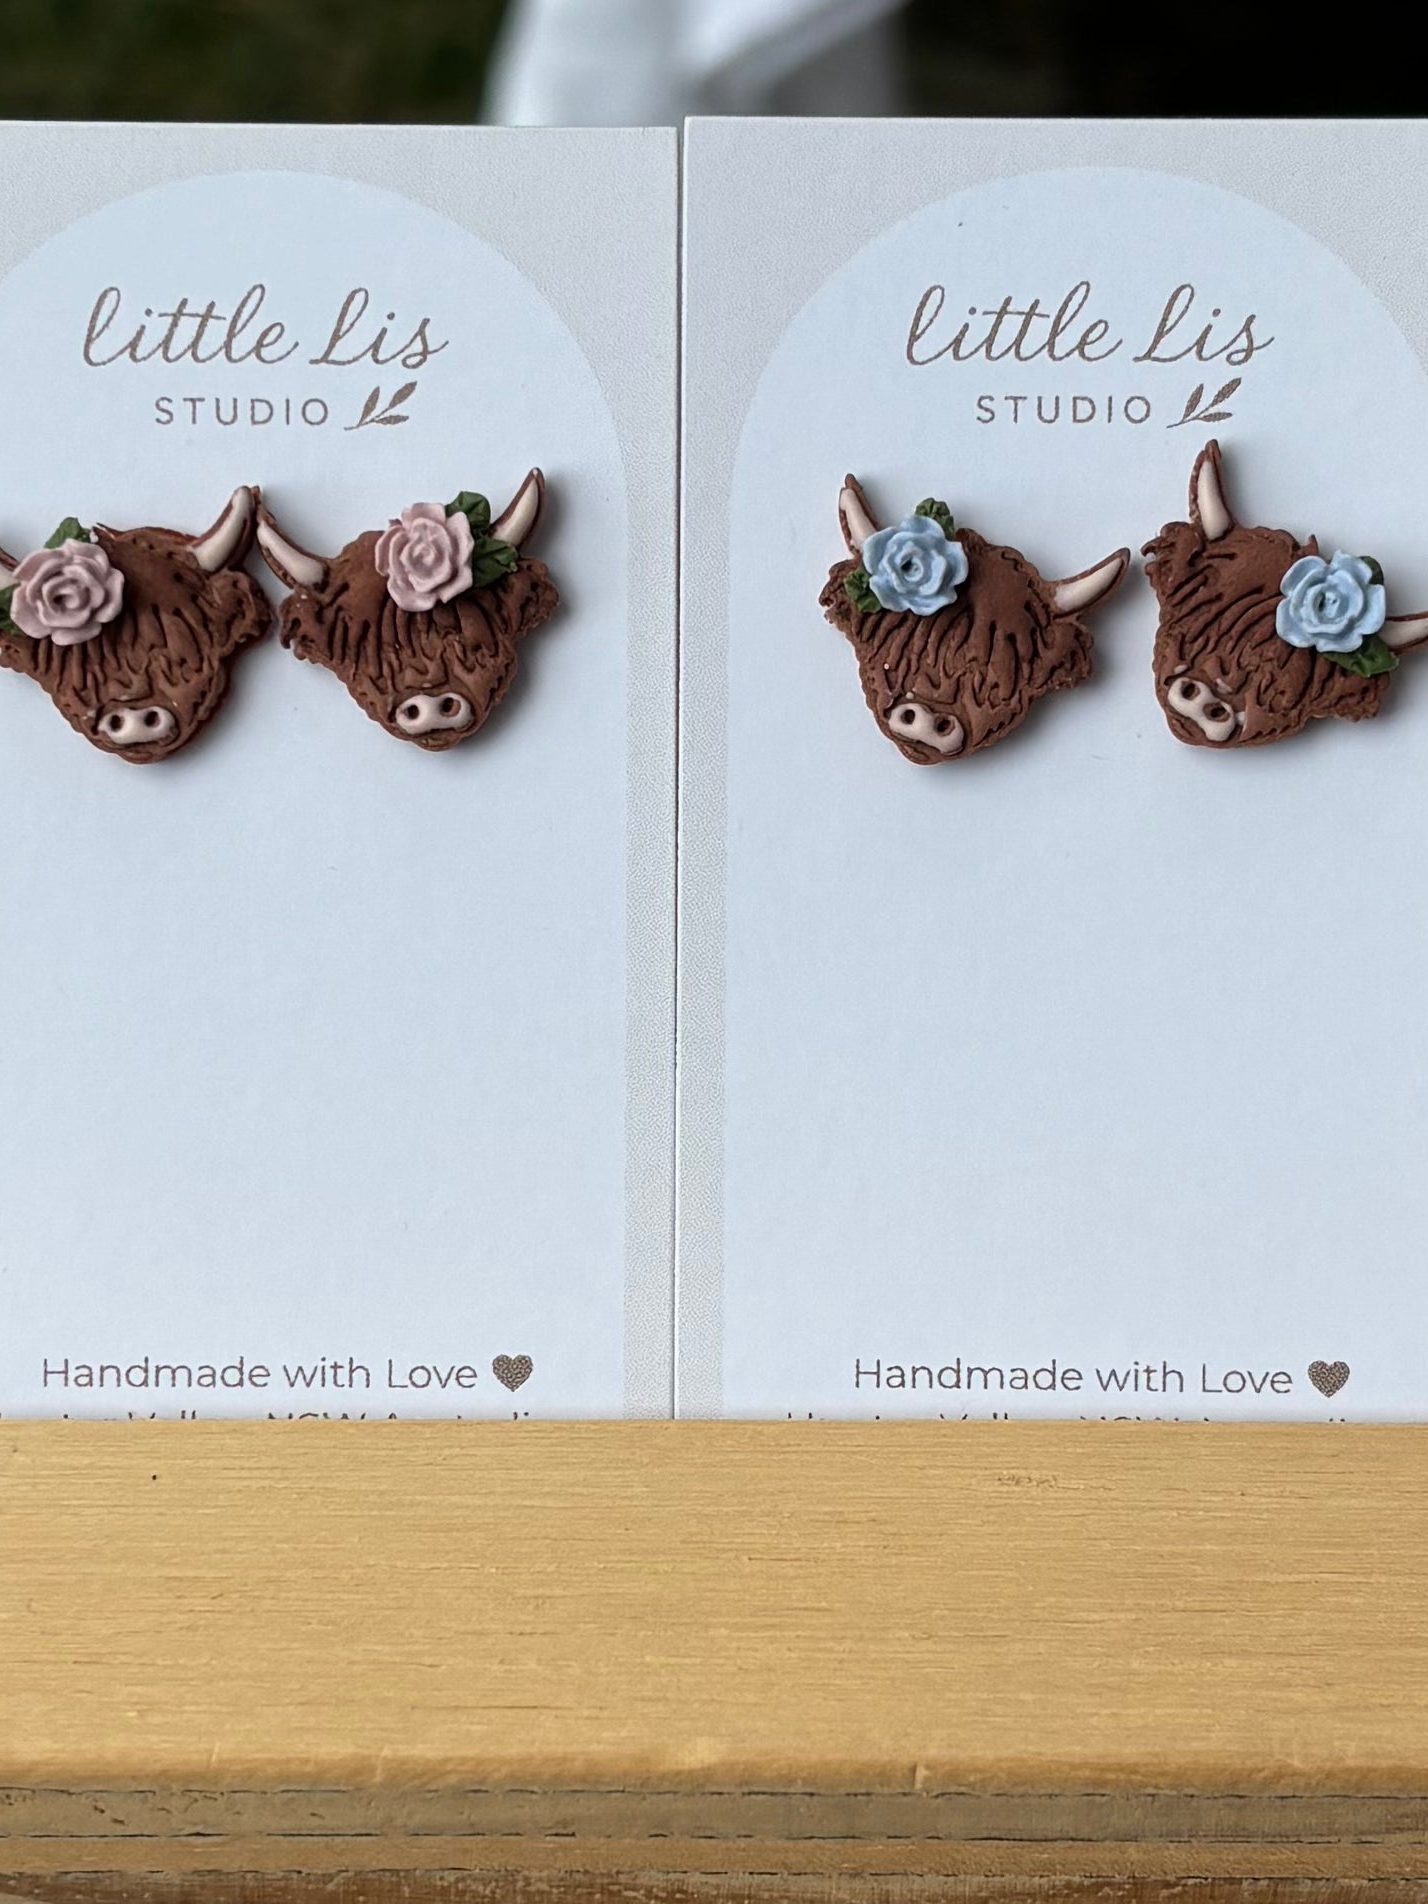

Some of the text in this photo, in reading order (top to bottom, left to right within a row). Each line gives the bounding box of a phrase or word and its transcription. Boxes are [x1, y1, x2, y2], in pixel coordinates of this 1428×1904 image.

[82, 283, 450, 370] little Lis
[906, 280, 1276, 367] little Lis
[154, 396, 329, 426] STUDIO
[976, 394, 1151, 425] STUDIO
[43, 1355, 478, 1389] Handmade with Love
[855, 1357, 1293, 1394] Handmade with Love
